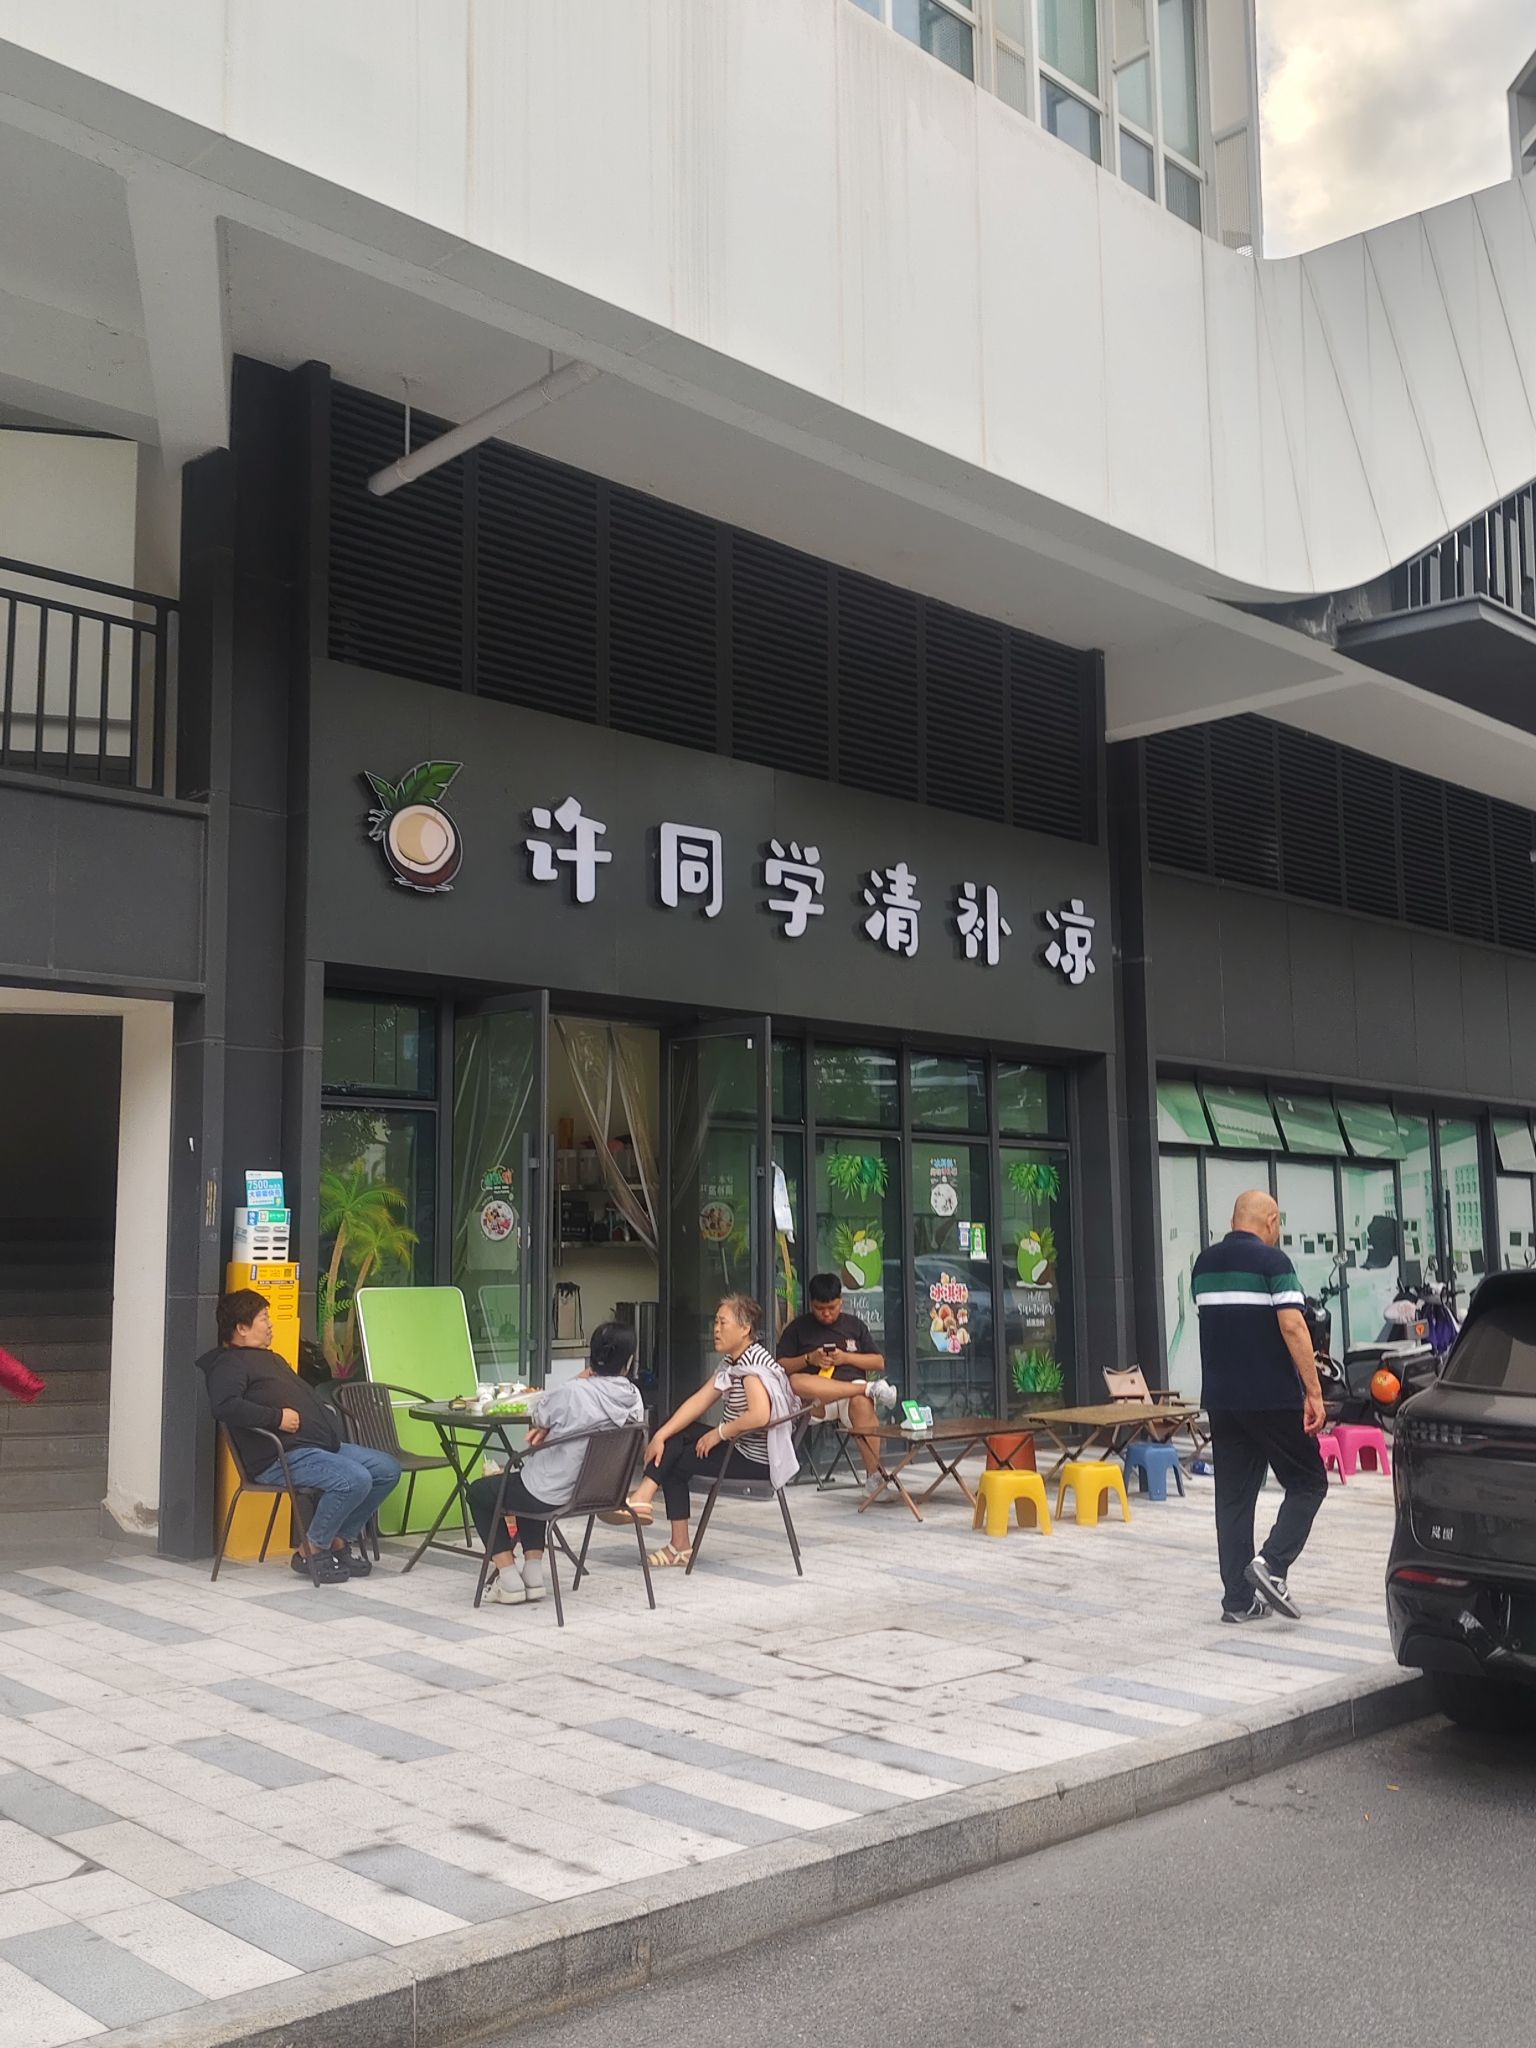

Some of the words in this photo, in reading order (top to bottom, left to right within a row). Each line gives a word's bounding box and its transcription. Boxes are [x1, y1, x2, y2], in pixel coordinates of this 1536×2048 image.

[526, 796, 1096, 985] 许同学清补凉
